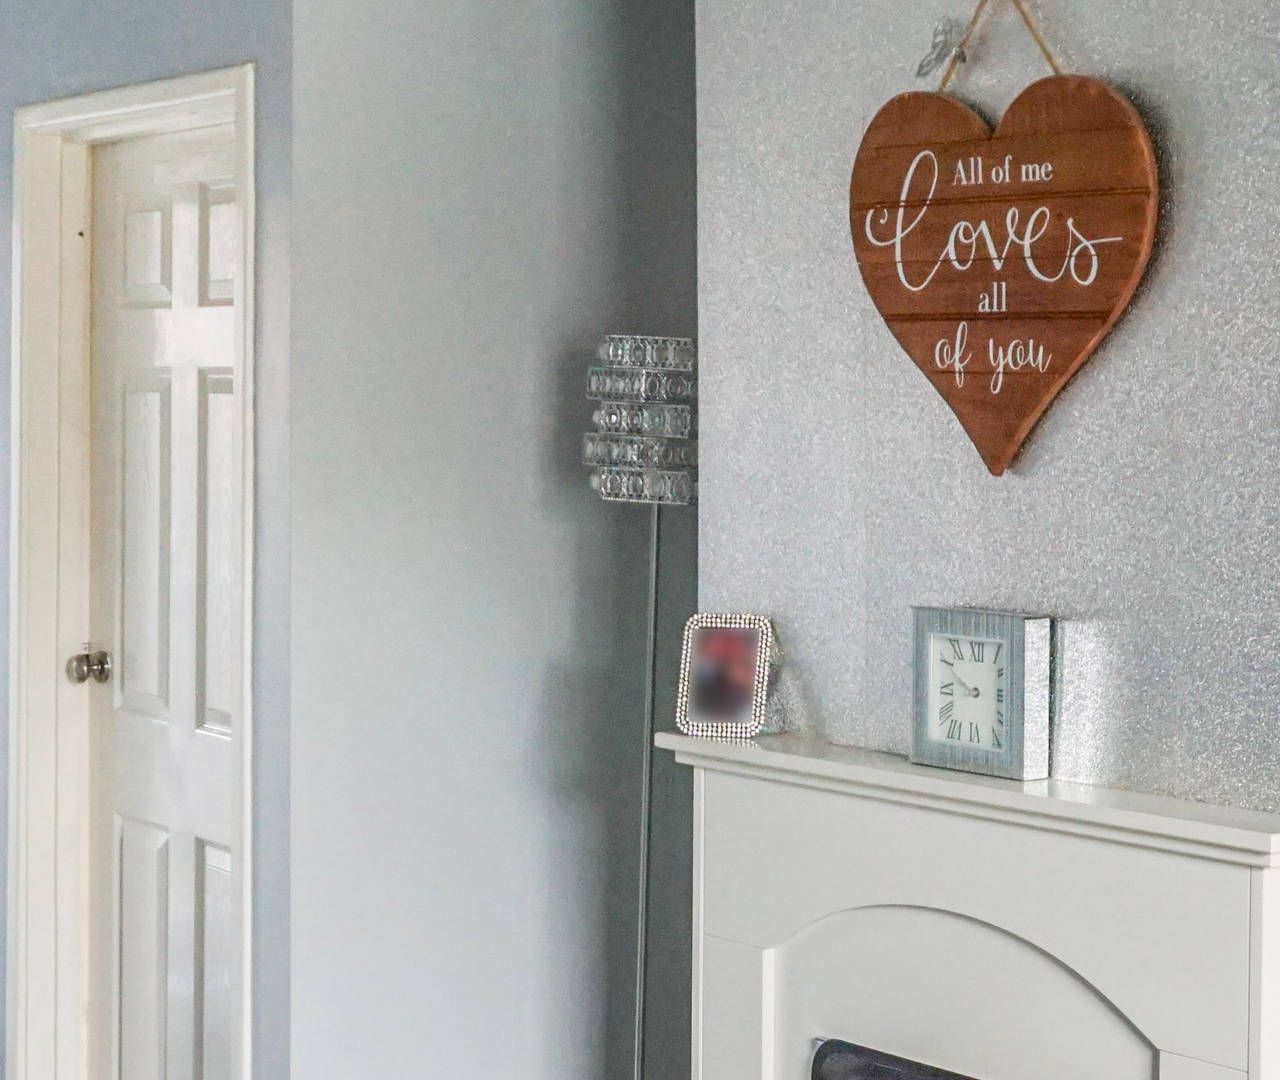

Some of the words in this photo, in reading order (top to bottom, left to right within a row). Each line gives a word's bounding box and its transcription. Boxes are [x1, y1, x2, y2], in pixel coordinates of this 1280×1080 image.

[952, 156, 983, 185] All
[991, 155, 1012, 184] of
[1020, 162, 1053, 182] me
[978, 282, 1007, 312] all
[934, 321, 973, 388] of
[988, 337, 1053, 394] you
